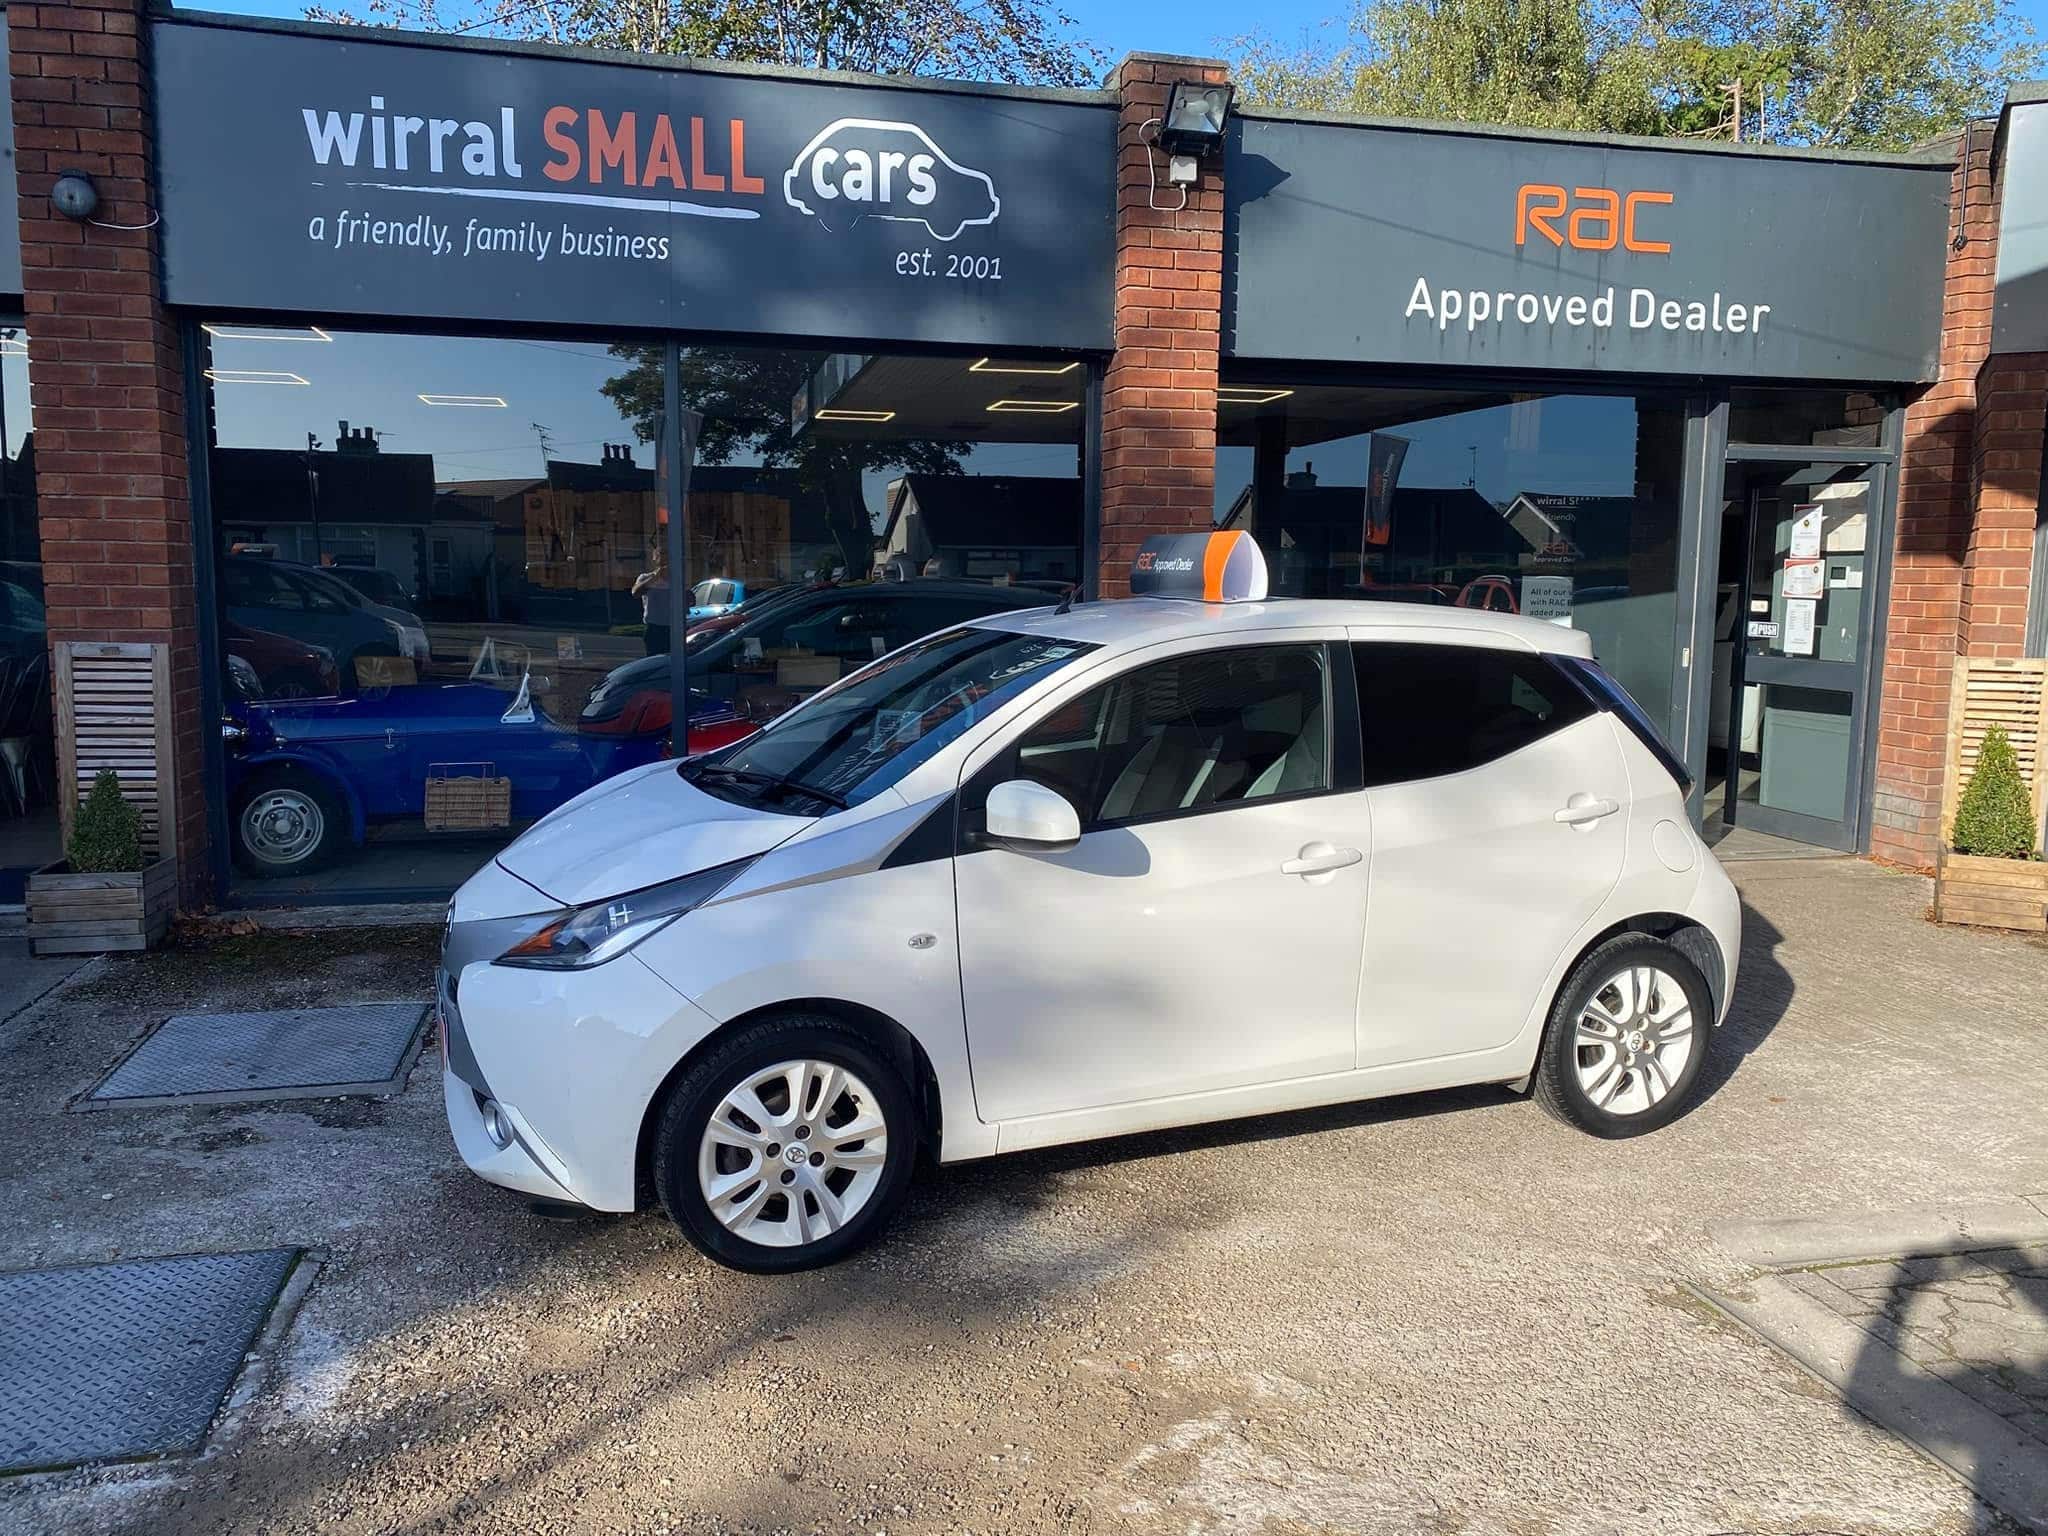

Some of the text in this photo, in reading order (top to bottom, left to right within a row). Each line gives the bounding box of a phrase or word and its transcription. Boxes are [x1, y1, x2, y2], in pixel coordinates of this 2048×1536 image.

[302, 96, 937, 205] wirral SMALL cars
[309, 210, 669, 261] a friendly, family business
[896, 247, 1002, 279] est. 2001
[1406, 278, 1770, 332] Approved Dealer
[1758, 624, 1777, 636] PUSH
